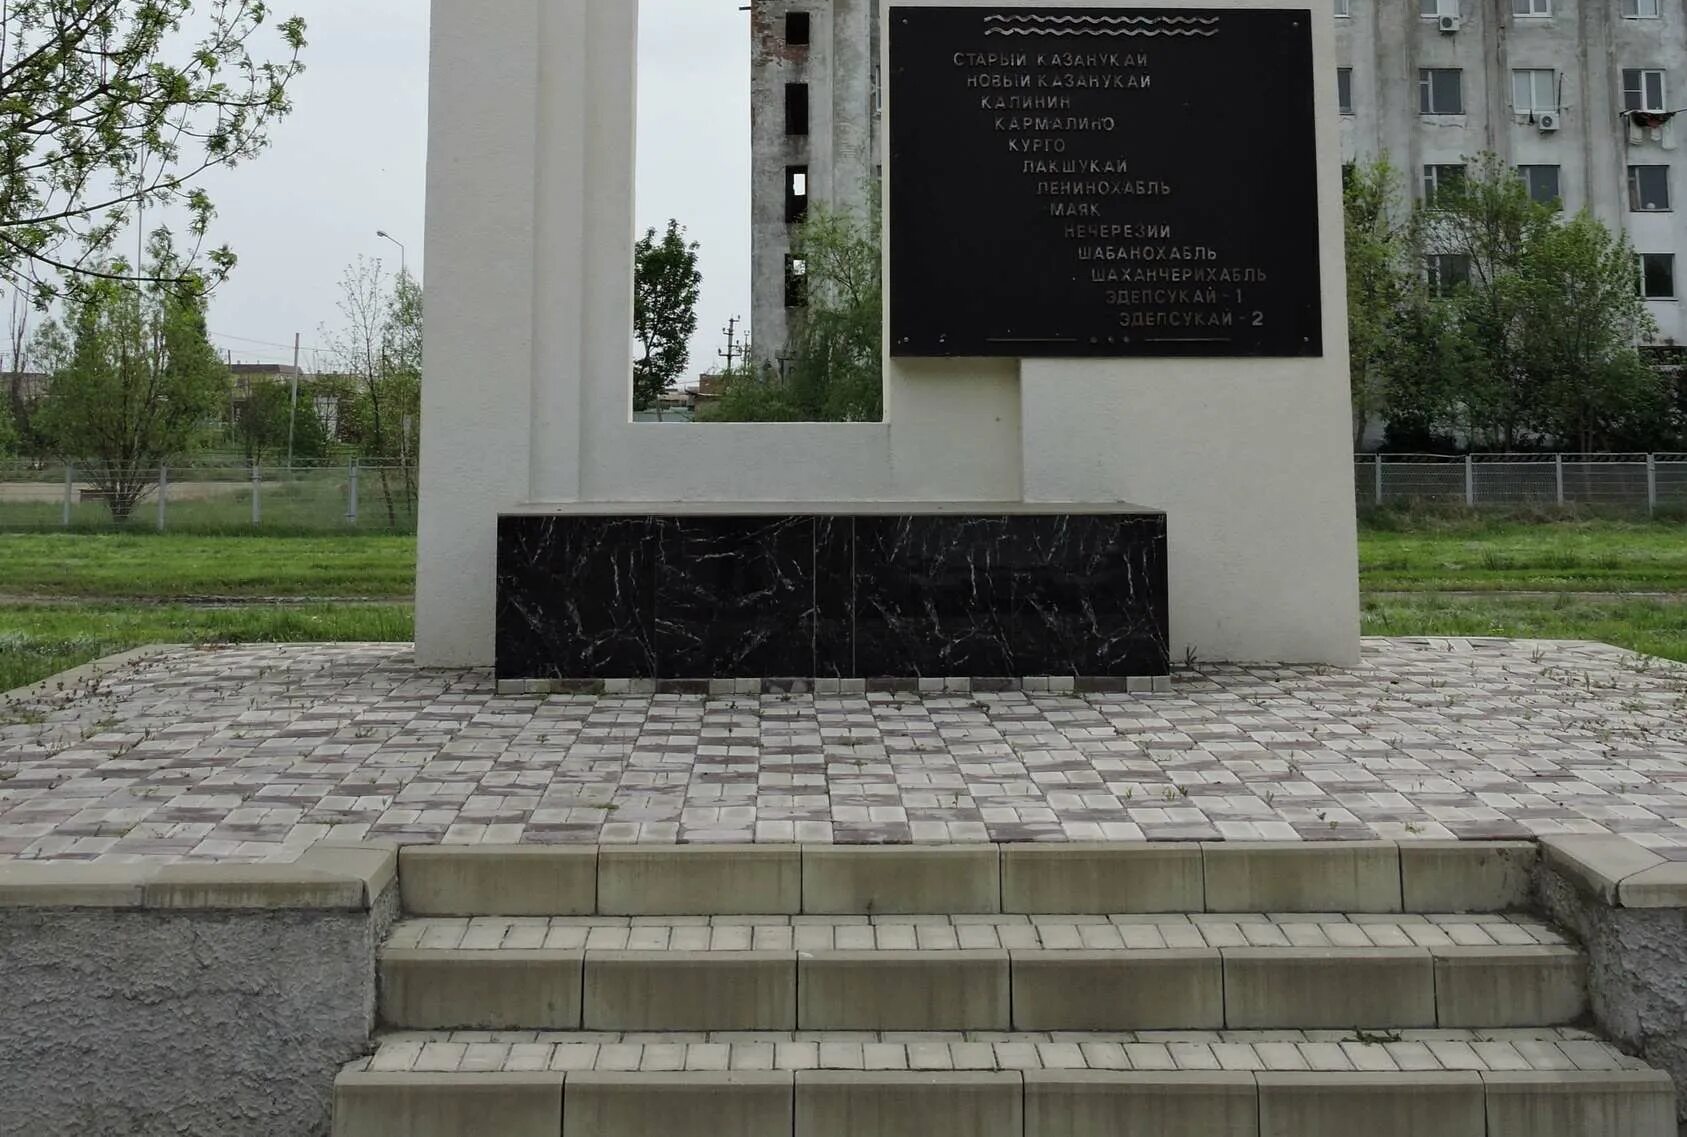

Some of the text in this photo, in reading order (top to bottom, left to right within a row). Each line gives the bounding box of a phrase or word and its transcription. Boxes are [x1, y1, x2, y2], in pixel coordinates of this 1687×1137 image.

[953, 49, 1148, 66] СТАРЫЙ КАЗАНУКАЙ
[967, 71, 1151, 88] НОВЫЙ КАЗАНУКАЙ
[981, 95, 1071, 109] КАЛИНИН
[994, 116, 1116, 131] КАРМАЛИНО
[1008, 138, 1066, 153] КУРГО
[1022, 155, 1128, 173] ЛАКШУКАЙ
[1036, 180, 1171, 195] ЛЕНИНОХАБЛЬ
[1050, 202, 1101, 217] МАЯК
[1064, 222, 1171, 238] НЕЧЕРЕЗИЙ
[1078, 246, 1217, 260] ШАБАНОХАБЛЬ
[1091, 268, 1267, 282] ШАХАНЧЕРИХАБЛЬ
[1105, 286, 1217, 305] ЭДЕПСУКАЙ
[1119, 308, 1233, 327] ЭДЕПСУКАЙ
[1251, 311, 1264, 326] 2
